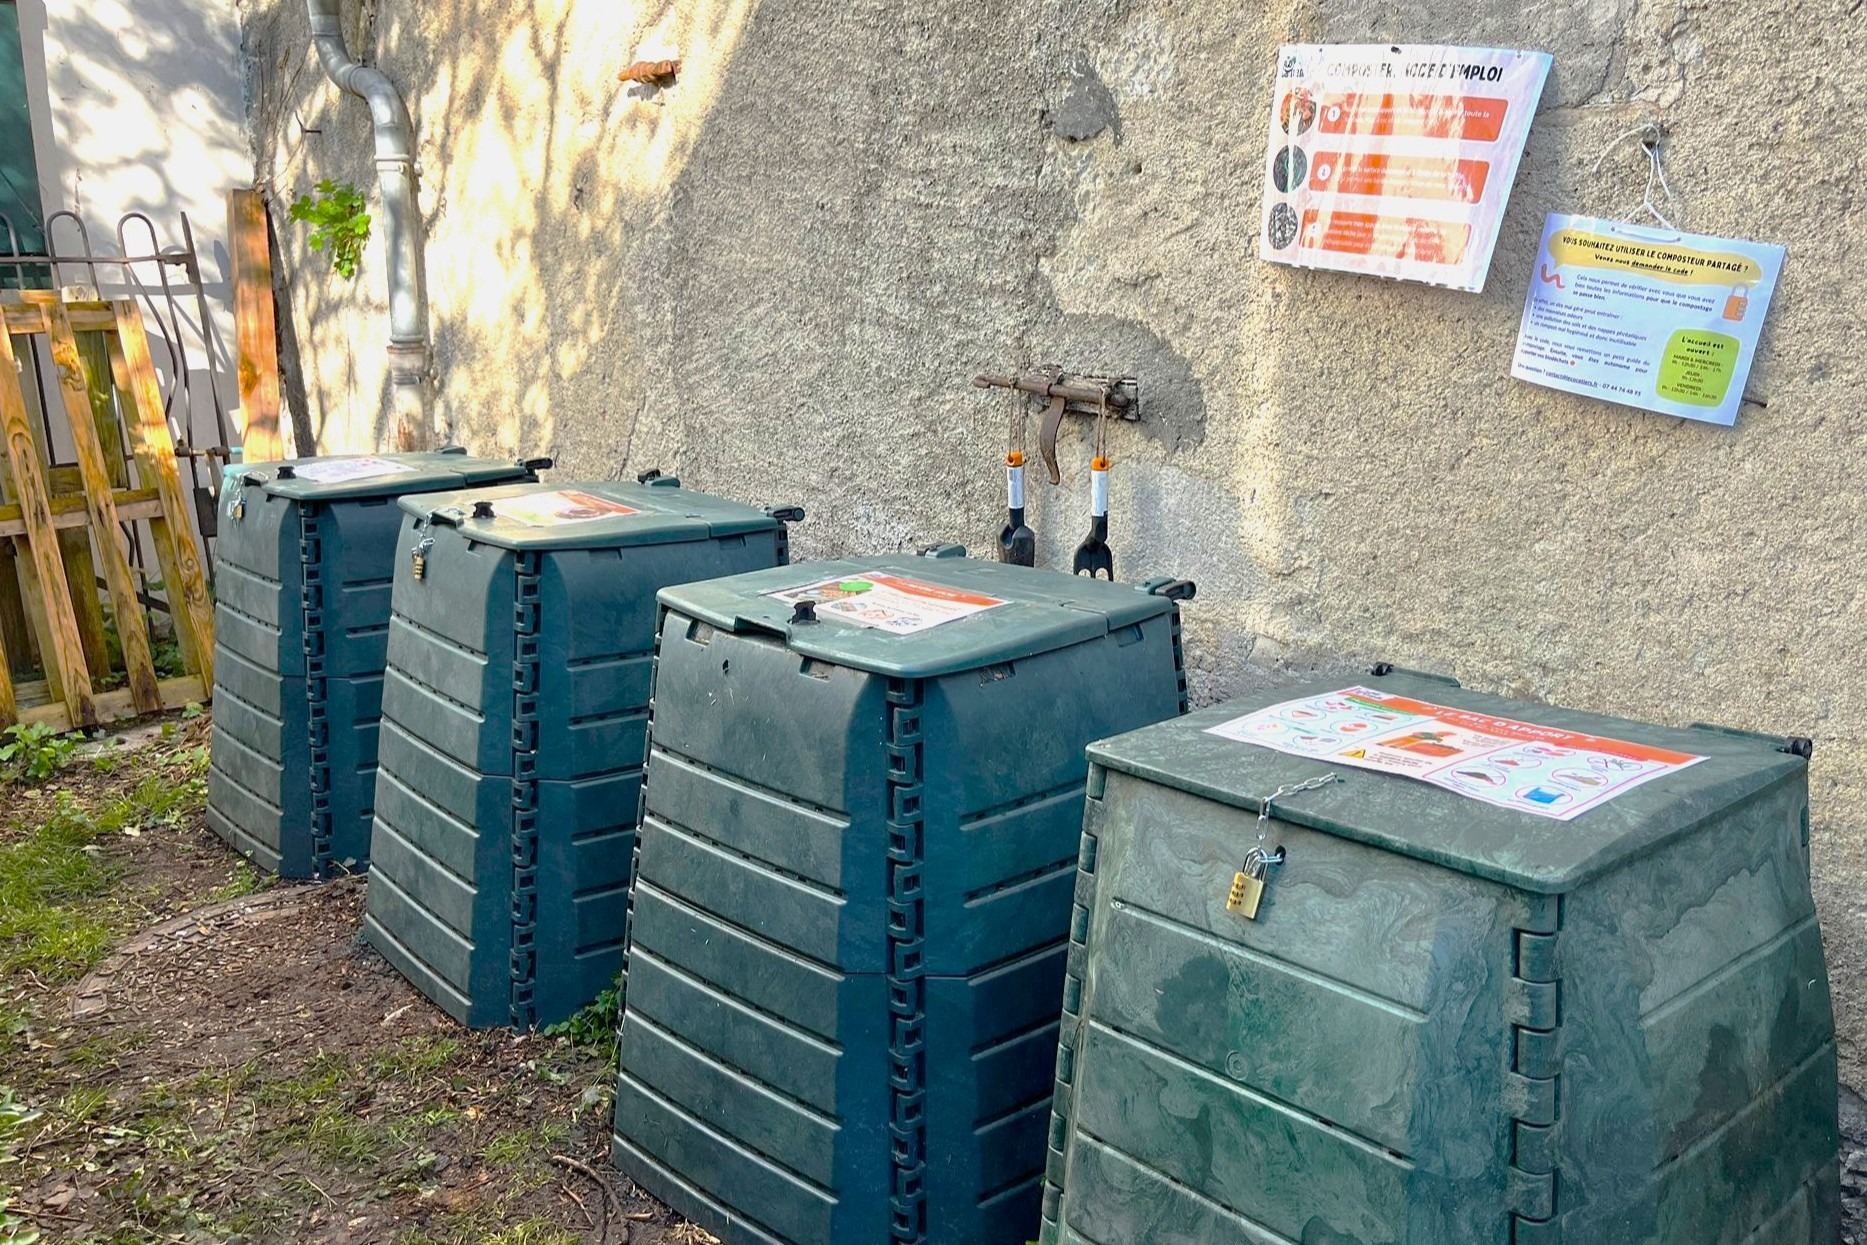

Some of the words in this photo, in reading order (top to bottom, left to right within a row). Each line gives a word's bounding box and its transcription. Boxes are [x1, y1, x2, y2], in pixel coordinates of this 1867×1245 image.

[1562, 237, 1577, 245] VOUS
[1578, 239, 1614, 251] SOUHAITEZ
[1615, 245, 1645, 256] UTILISER
[1656, 251, 1705, 265] COMPOSTEUR
[1706, 258, 1742, 271] PARTAGÉ
[1631, 260, 1664, 271] demander
[1672, 267, 1689, 275] code
